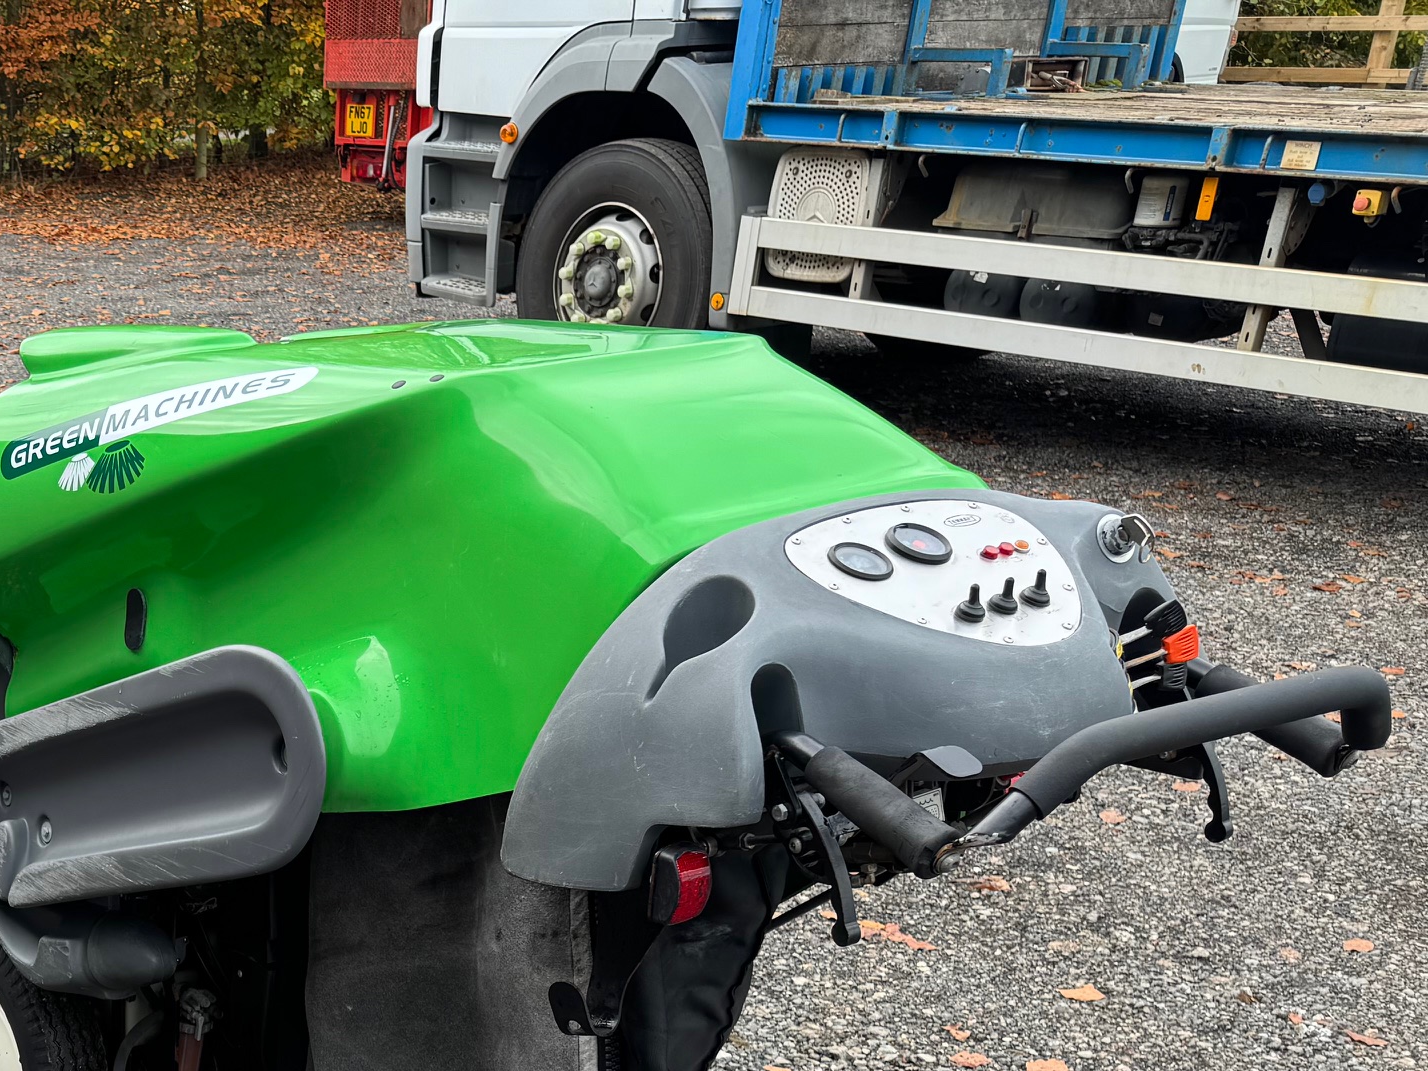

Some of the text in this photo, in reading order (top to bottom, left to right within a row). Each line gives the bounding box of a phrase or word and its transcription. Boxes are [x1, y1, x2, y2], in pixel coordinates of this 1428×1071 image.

[349, 106, 371, 119] FN67
[351, 121, 368, 134] LJO
[9, 372, 296, 469] GREEN MACHINES
